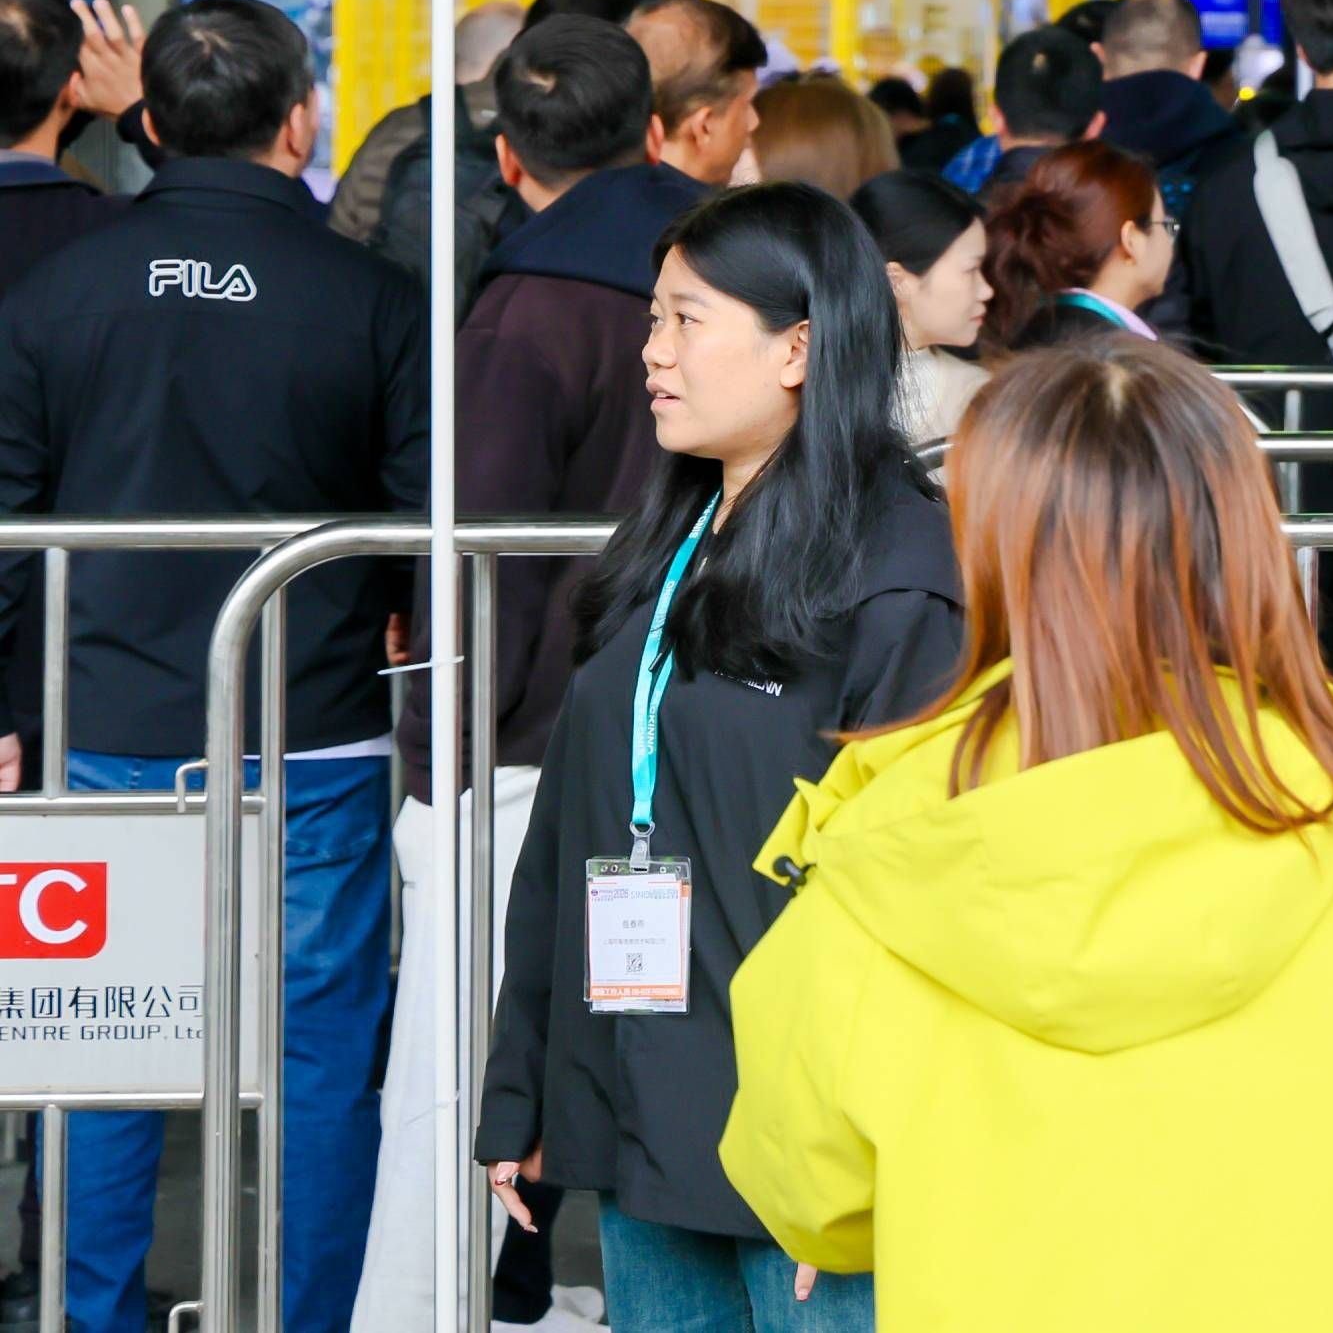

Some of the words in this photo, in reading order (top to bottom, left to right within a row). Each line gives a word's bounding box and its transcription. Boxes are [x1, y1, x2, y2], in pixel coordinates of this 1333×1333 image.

[148, 259, 257, 302] FILA
[0, 985, 204, 1019] 集团有限公司
